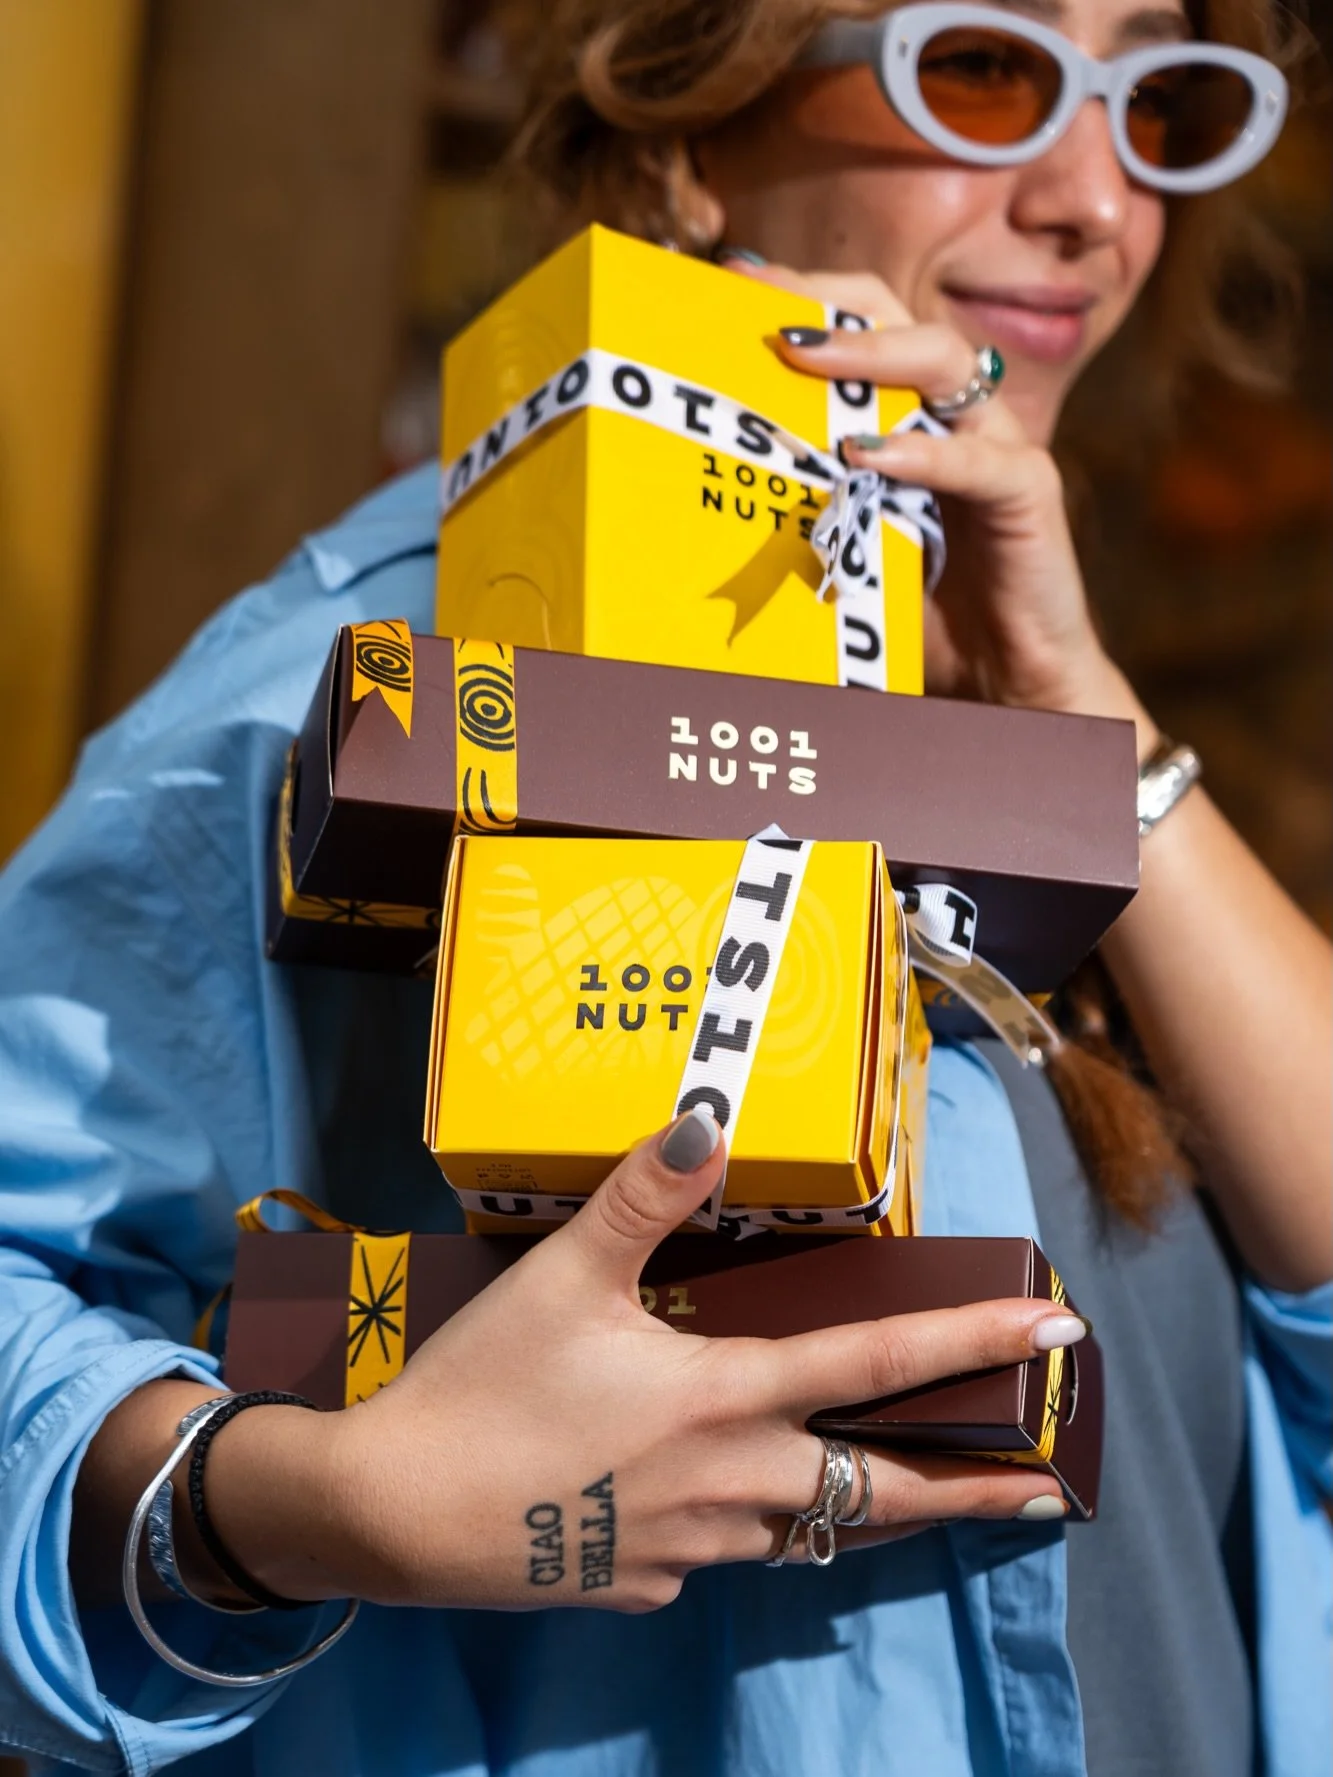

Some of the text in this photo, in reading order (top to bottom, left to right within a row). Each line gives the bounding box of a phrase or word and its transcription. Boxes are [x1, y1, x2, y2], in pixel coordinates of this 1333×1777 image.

[703, 452, 820, 510] 1001
[702, 486, 816, 542] NUTS
[671, 716, 818, 760] 1001
[668, 752, 817, 795] NUTS
[580, 964, 713, 993] 100
[576, 1003, 689, 1031] NUT
[525, 1503, 565, 1585] CIAO
[580, 1471, 616, 1592] BELLA
